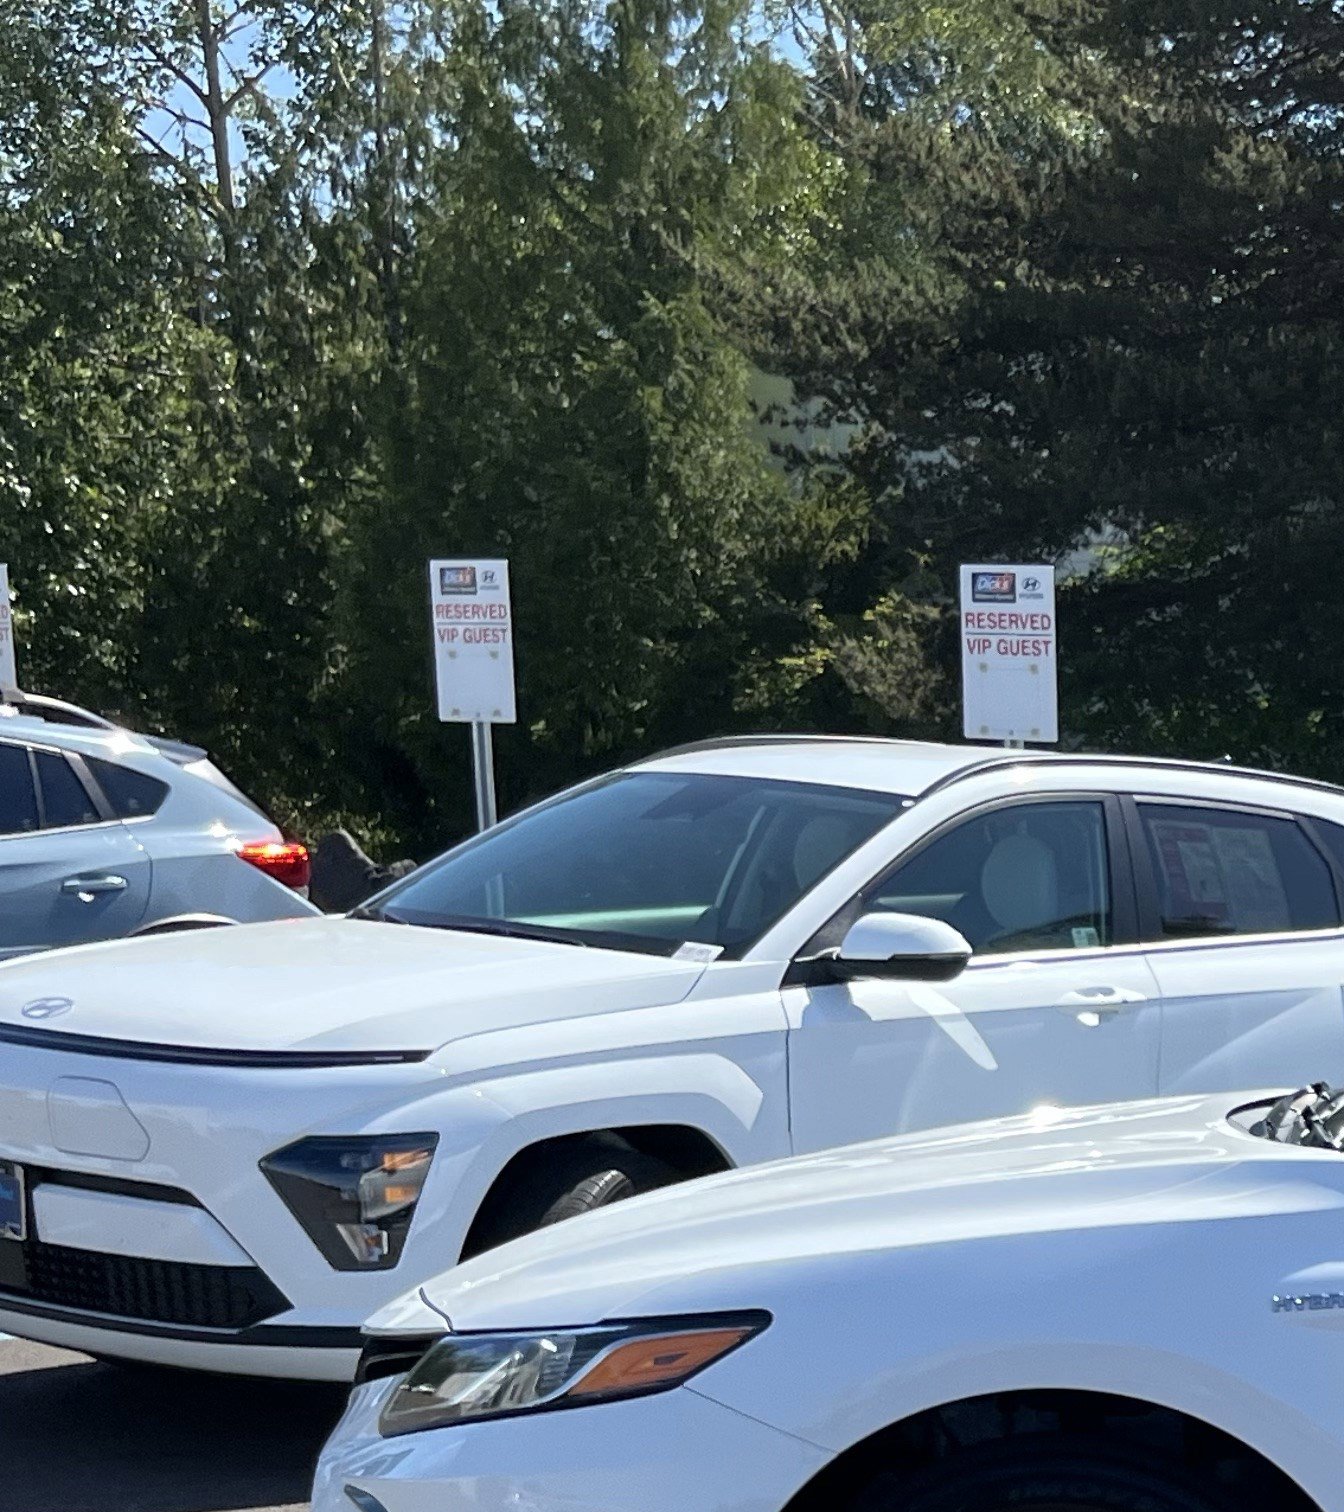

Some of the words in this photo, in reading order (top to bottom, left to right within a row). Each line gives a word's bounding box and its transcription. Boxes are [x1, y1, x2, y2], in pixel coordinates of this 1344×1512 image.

[435, 603, 507, 619] RESERVED
[965, 612, 1052, 631] RESERVED
[437, 628, 459, 644] VIP
[462, 627, 508, 644] GUEST
[967, 638, 992, 655] VIP
[997, 638, 1052, 656] GUEST
